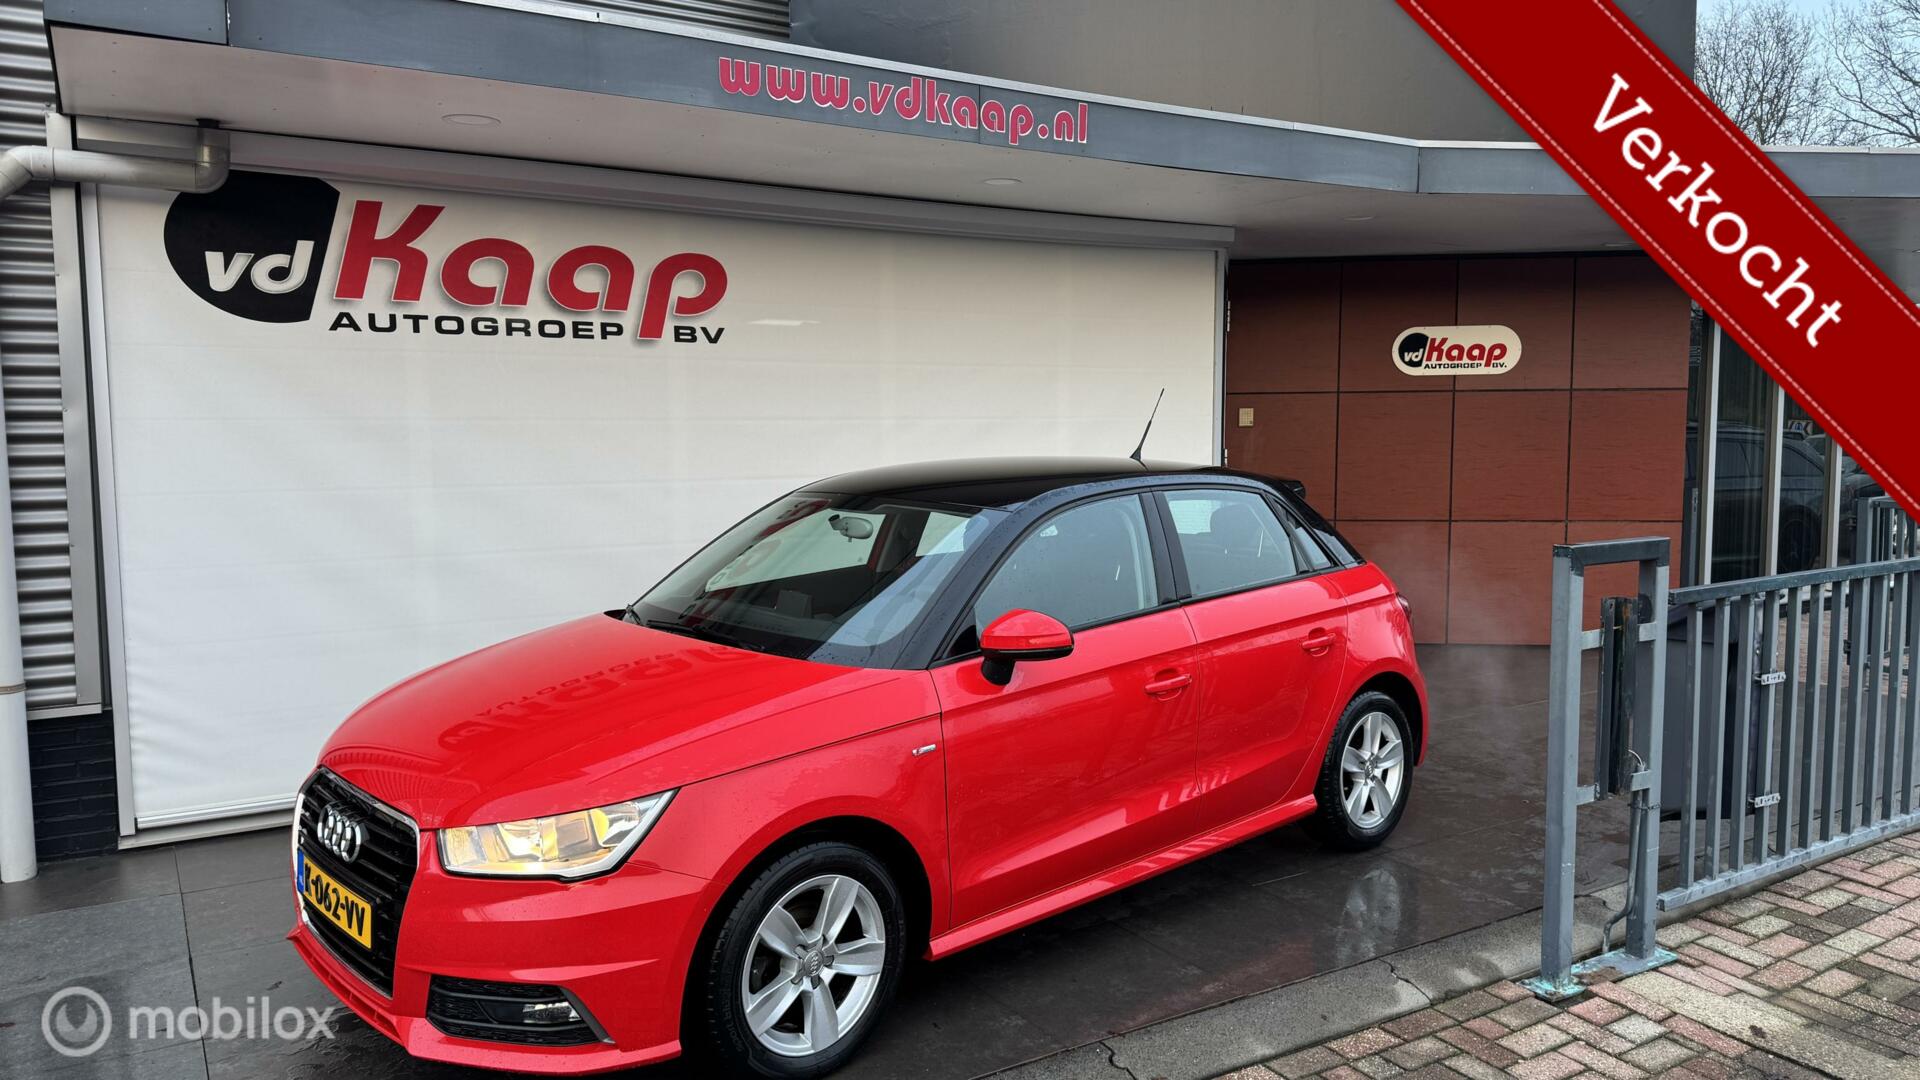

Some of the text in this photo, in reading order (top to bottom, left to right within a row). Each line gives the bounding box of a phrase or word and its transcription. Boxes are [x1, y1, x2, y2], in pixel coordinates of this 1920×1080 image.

[718, 57, 1089, 146] www.vdkaap.nl
[204, 199, 729, 341] vd Kaap
[328, 311, 726, 344] AUTOGROEP BV
[1403, 337, 1508, 368] vd Kaap
[304, 862, 366, 937] K-062-VV
